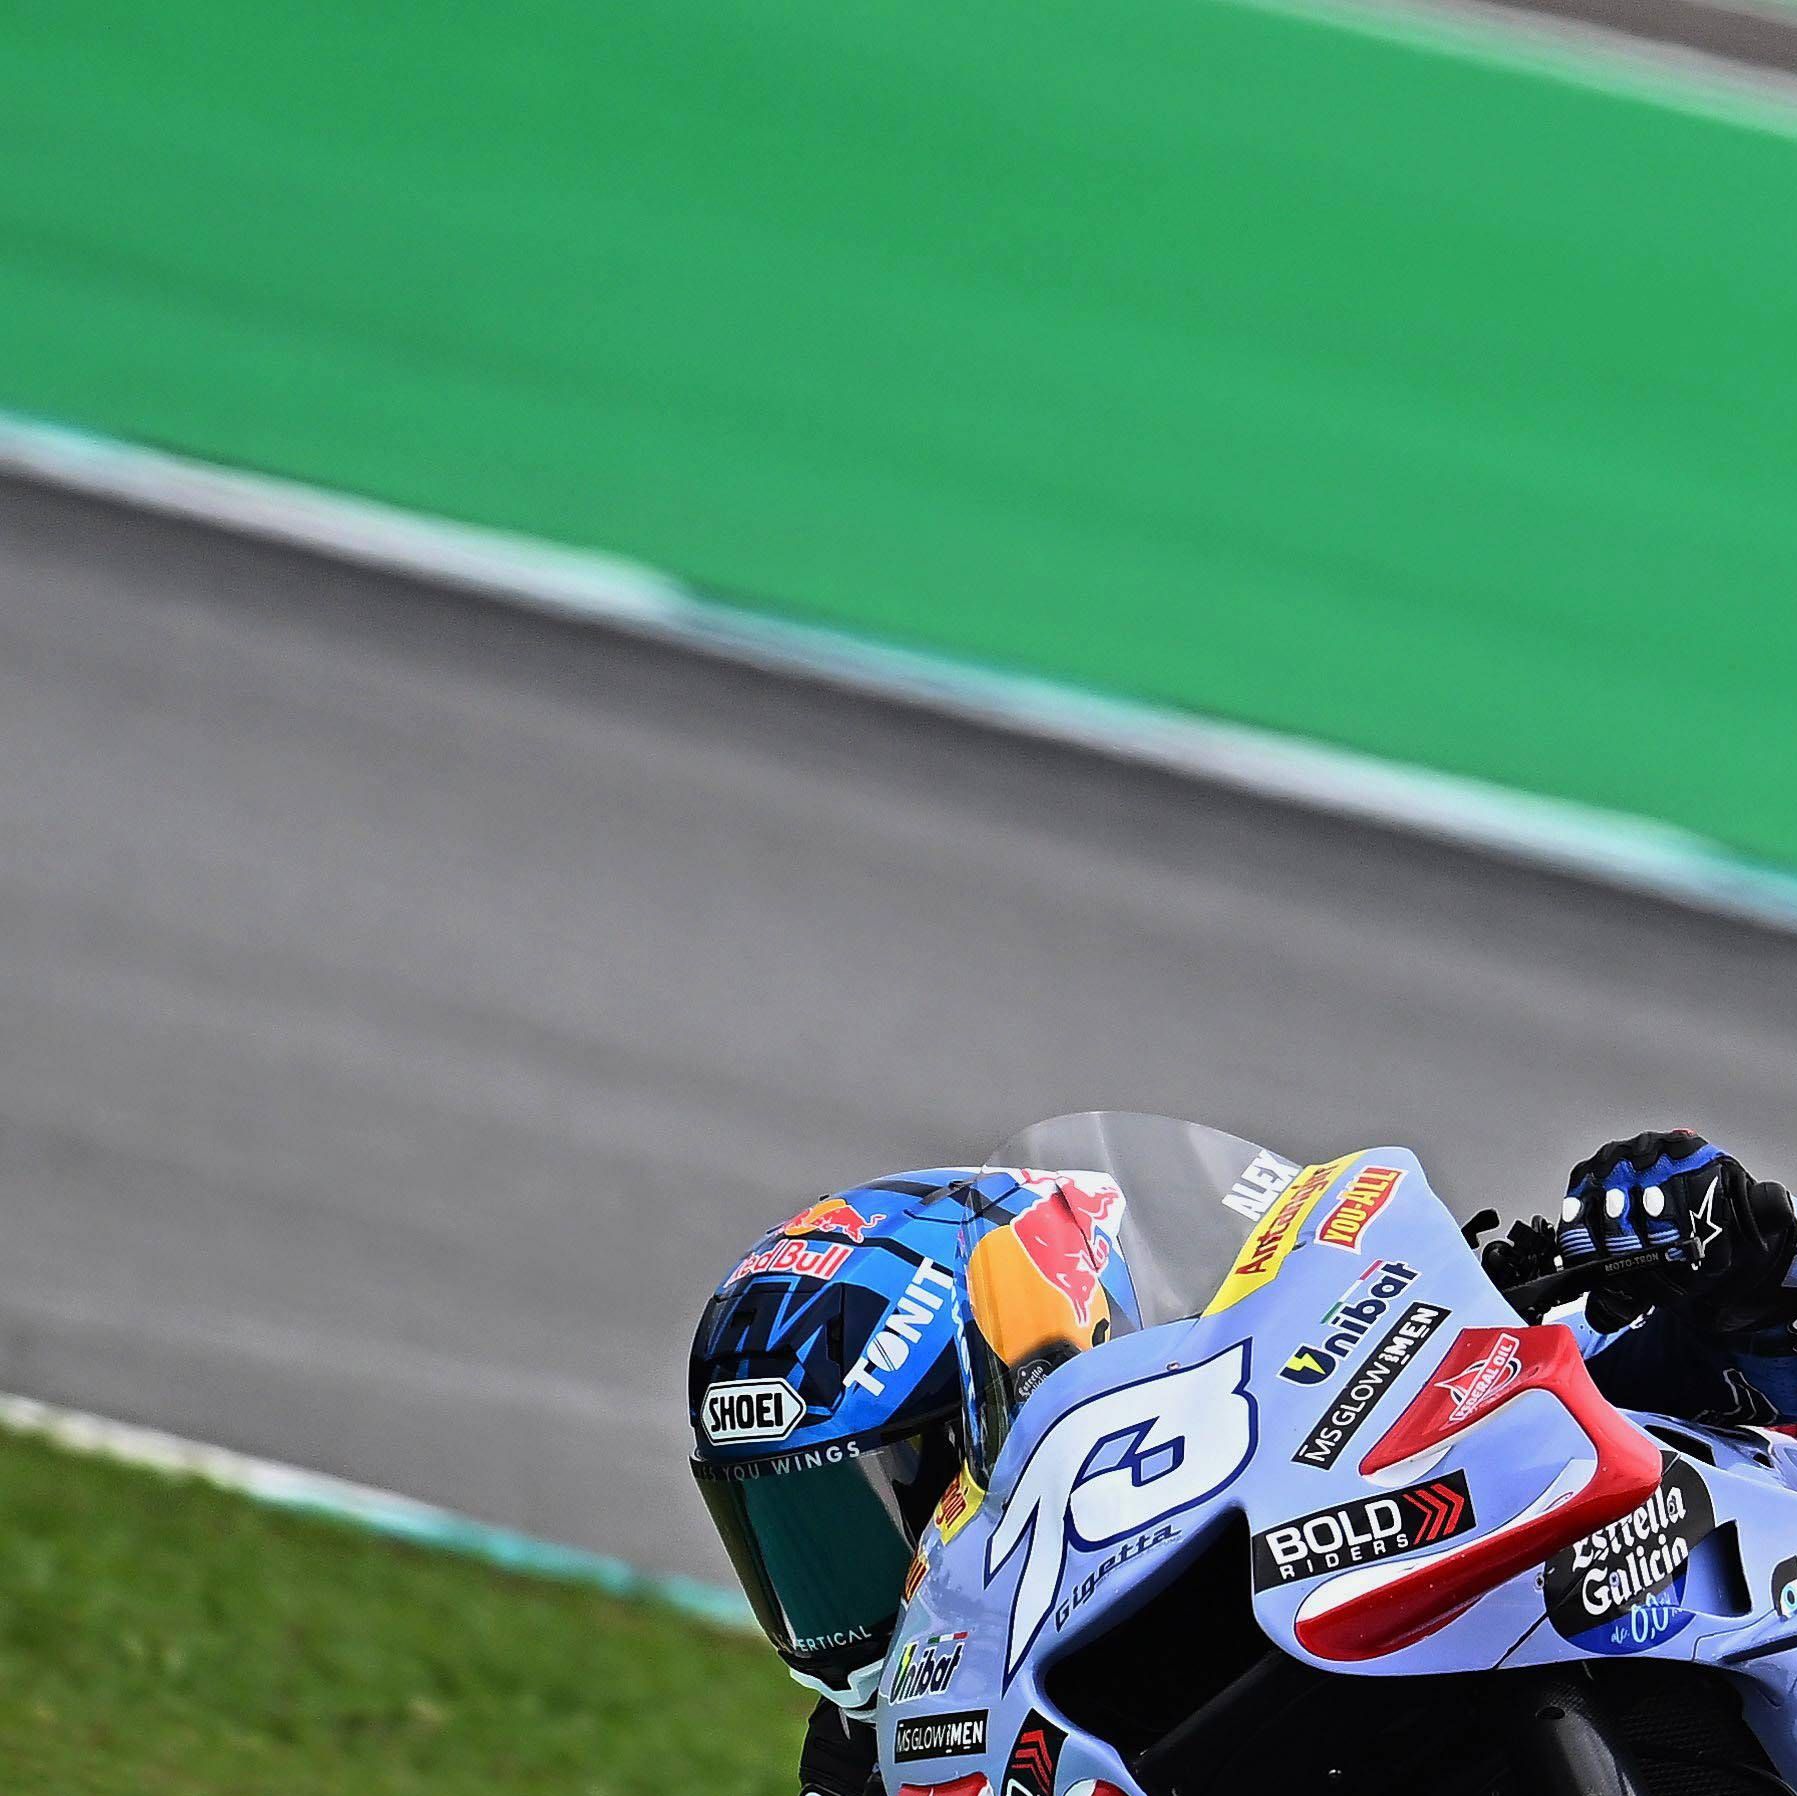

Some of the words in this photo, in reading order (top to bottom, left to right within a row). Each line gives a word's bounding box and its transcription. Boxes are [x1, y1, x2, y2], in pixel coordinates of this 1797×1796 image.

[1222, 1150, 1300, 1222] ALEX
[769, 1239, 854, 1281] Bull
[1279, 1261, 1421, 1384] Unibat
[1332, 1362, 1391, 1426] GLOW
[1384, 1307, 1440, 1365] MEN
[1493, 1344, 1513, 1366] OIL
[709, 1392, 784, 1433] SHOEI
[771, 1440, 861, 1477] WINGS
[1265, 1498, 1402, 1565] BOLD
[1572, 1486, 1687, 1572] Estrella
[1280, 1532, 1410, 1580] RIDERS
[796, 1625, 872, 1652] ERTICAL
[890, 1642, 965, 1703] Unibat
[951, 1720, 984, 1750] MEN
